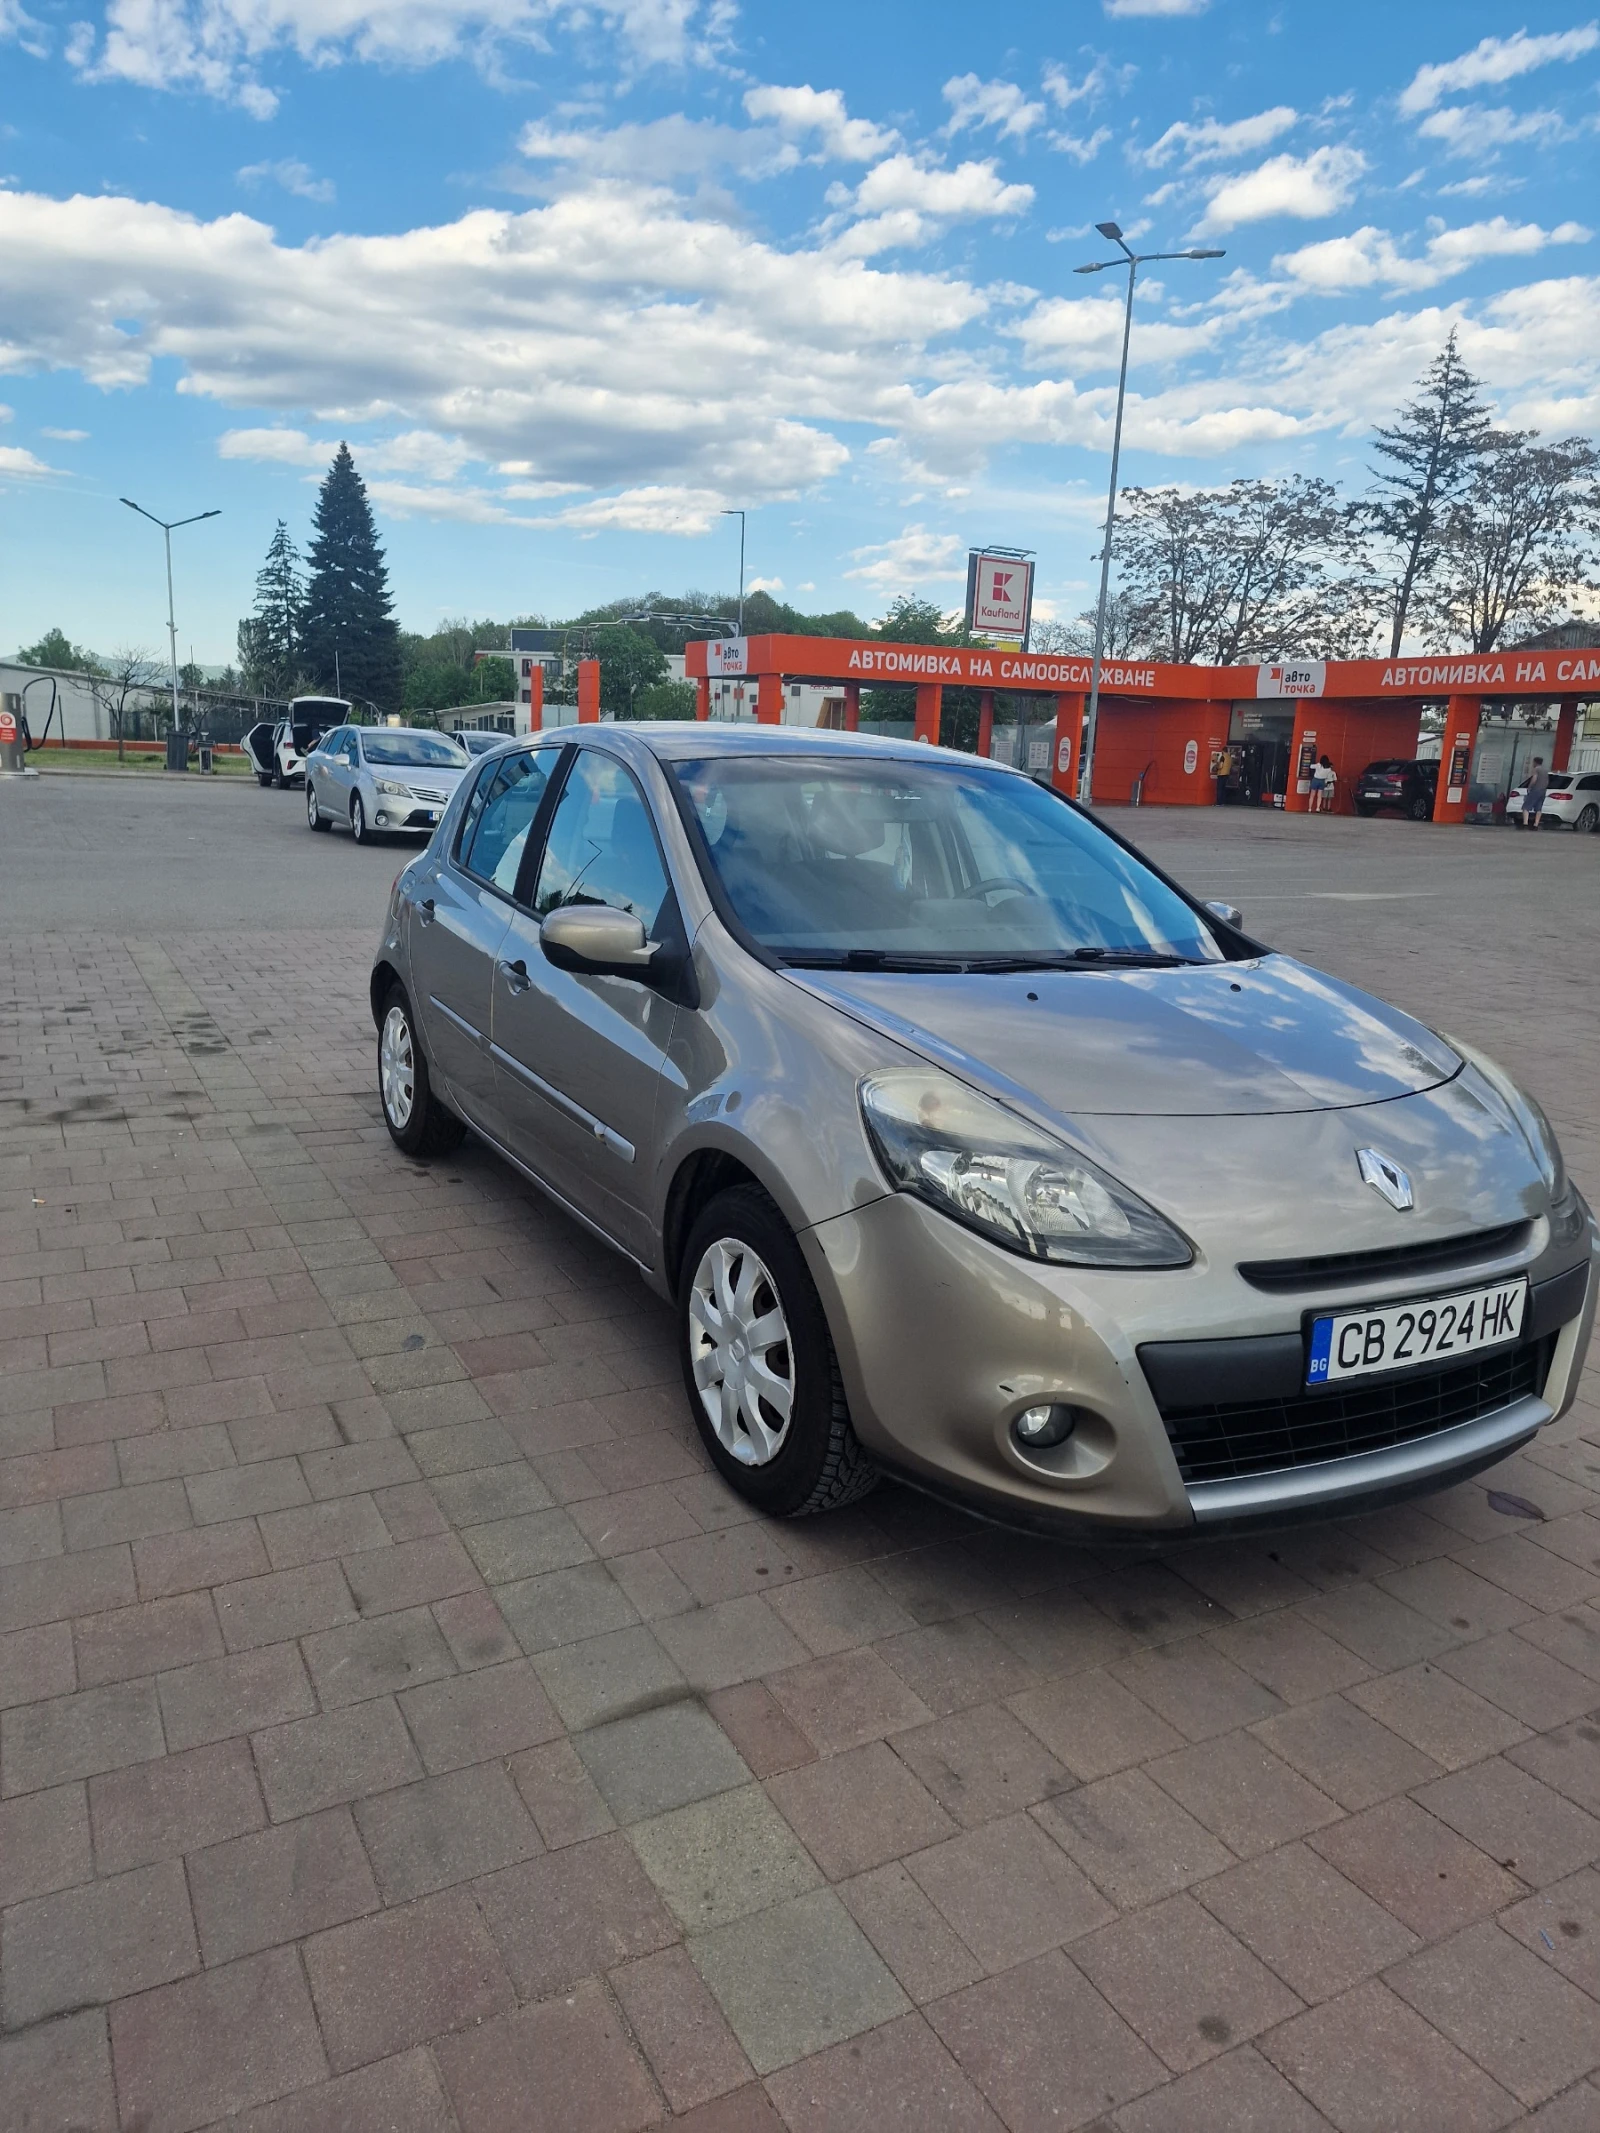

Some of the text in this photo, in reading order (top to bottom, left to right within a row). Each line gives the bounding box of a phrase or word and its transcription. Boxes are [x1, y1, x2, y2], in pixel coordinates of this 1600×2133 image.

[981, 606, 1020, 620] Kaufland
[723, 661, 743, 671] точка
[848, 650, 962, 675] АВТОМИВКА
[969, 658, 994, 677] НА
[1285, 671, 1311, 683] авто
[1381, 663, 1505, 686] АВТОМИВКА
[1515, 662, 1546, 682] НА
[1284, 684, 1316, 694] точка
[1337, 1289, 1519, 1369] CB 2924 HK
[1310, 1358, 1328, 1373] BG
